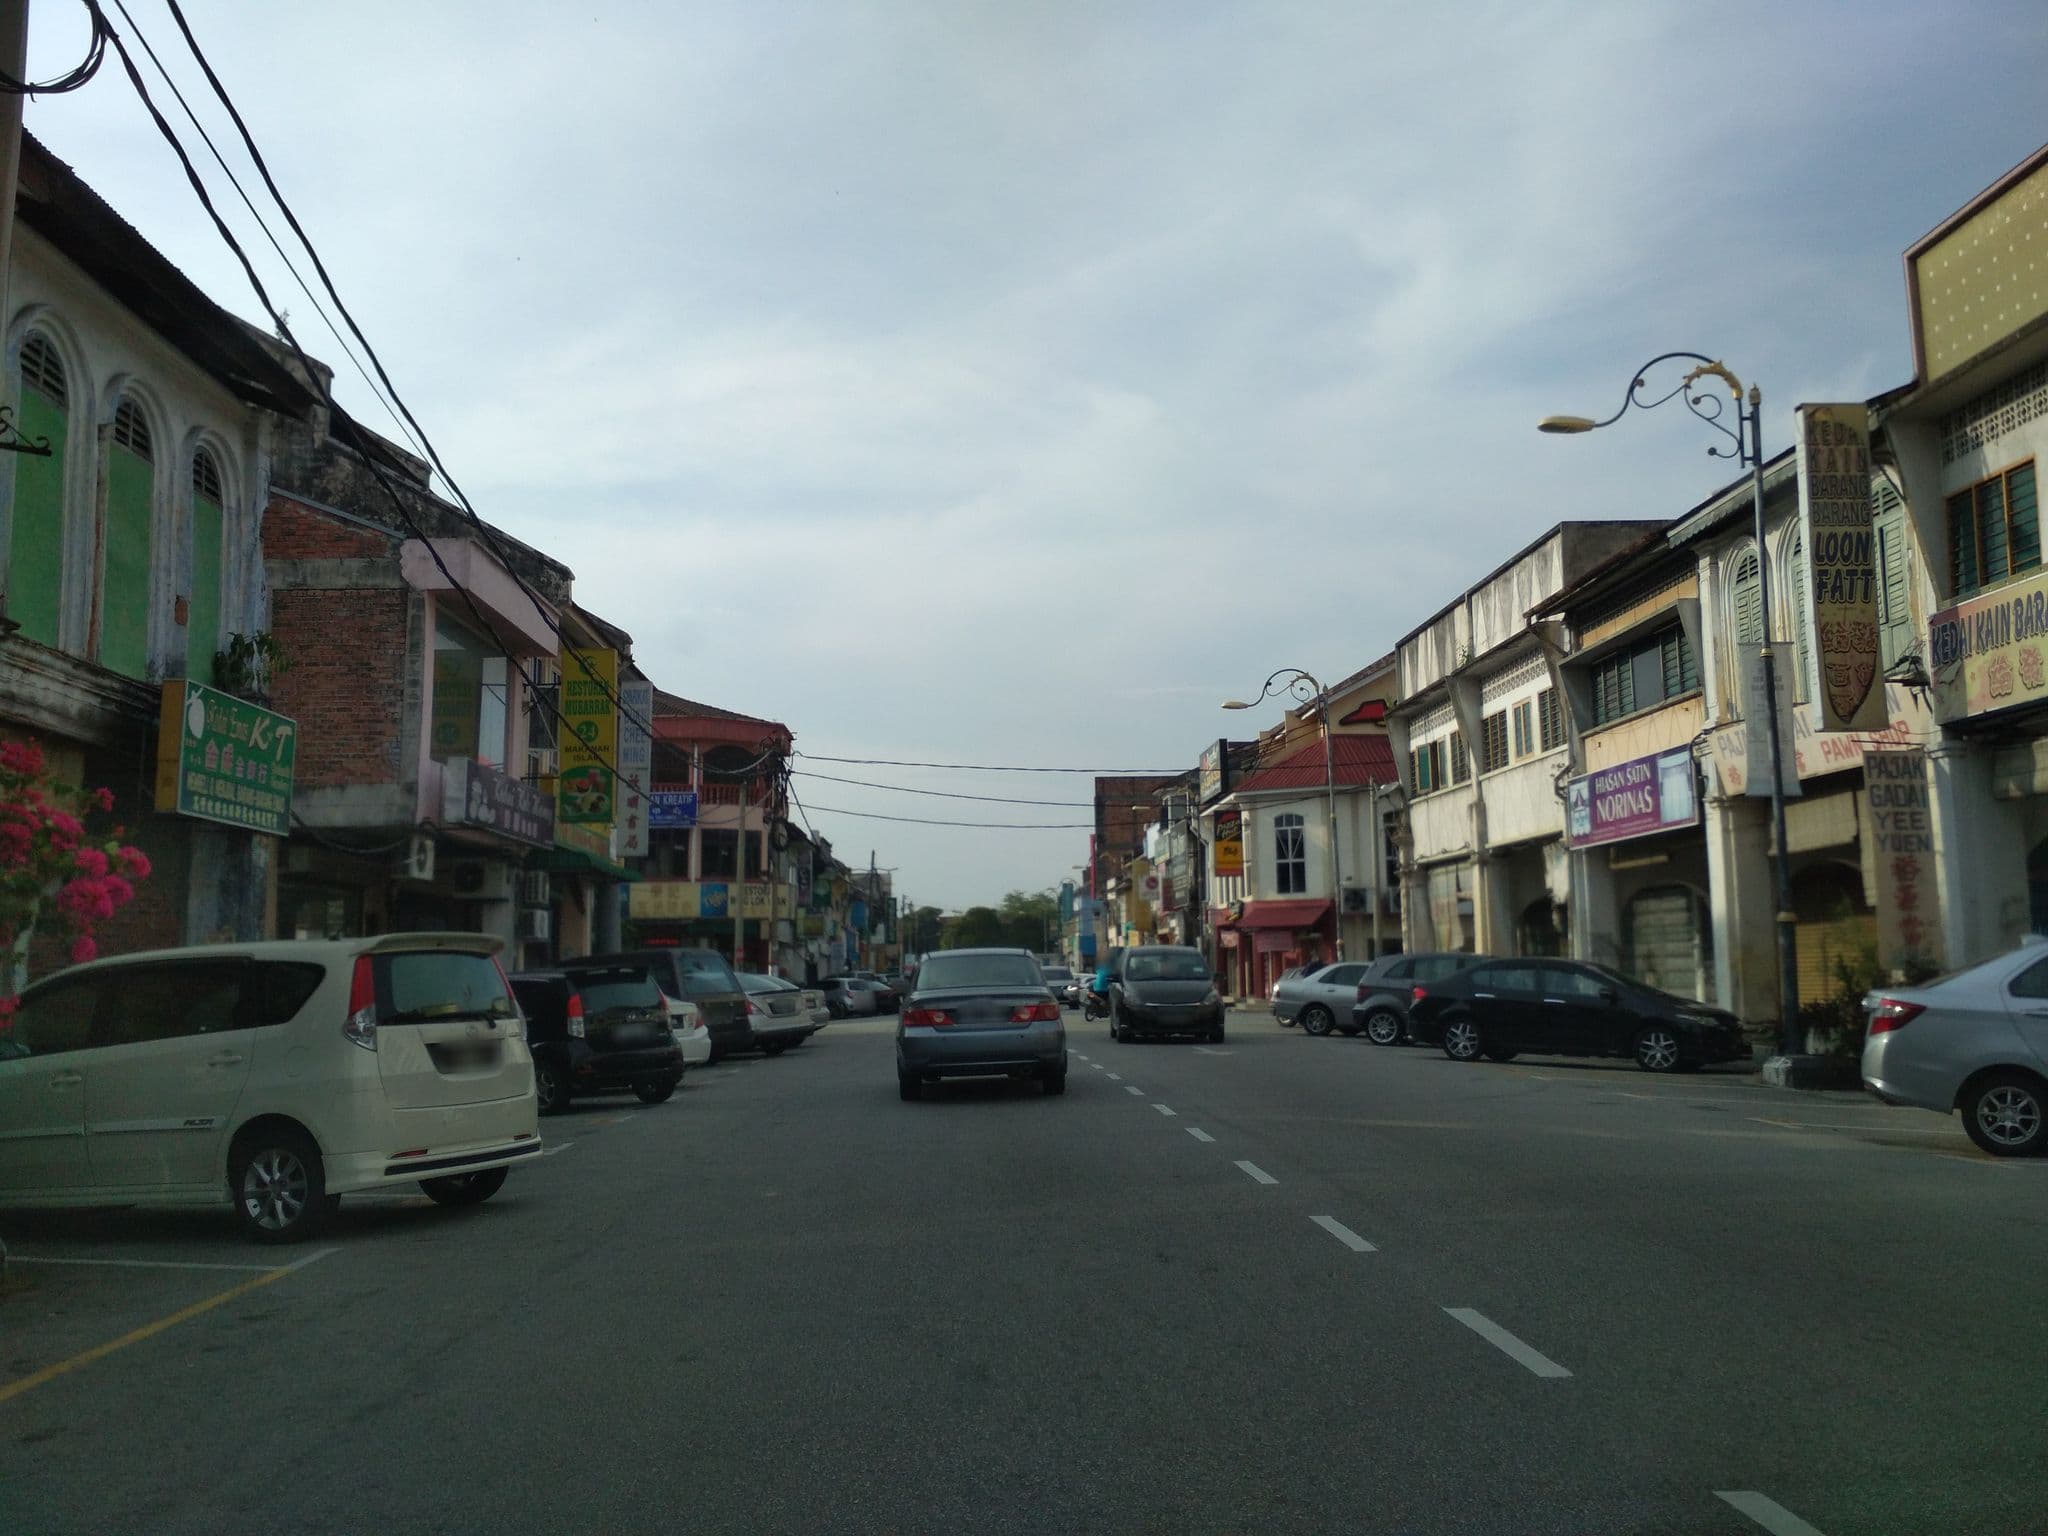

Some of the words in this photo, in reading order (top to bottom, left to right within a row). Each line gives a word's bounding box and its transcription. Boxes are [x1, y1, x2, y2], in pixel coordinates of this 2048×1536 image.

[1810, 475, 1868, 500] BARANG
[1811, 501, 1871, 527] BARANG
[1813, 531, 1871, 567] LOON
[1815, 568, 1873, 604] FATT
[1931, 615, 1972, 669] KEDAI
[1976, 601, 2010, 655] KAIN
[1820, 733, 1864, 763] PAWN
[1869, 720, 1910, 752] SHOP
[1595, 771, 1625, 795] HIASAN
[1626, 763, 1651, 786] SATIN
[1866, 754, 1926, 779] PAJAK
[663, 795, 693, 805] KREATIF
[1596, 785, 1654, 824] NORINAS
[1870, 784, 1927, 809] GADAI
[1875, 812, 1925, 831] YEE
[1877, 834, 1931, 853] YUEN
